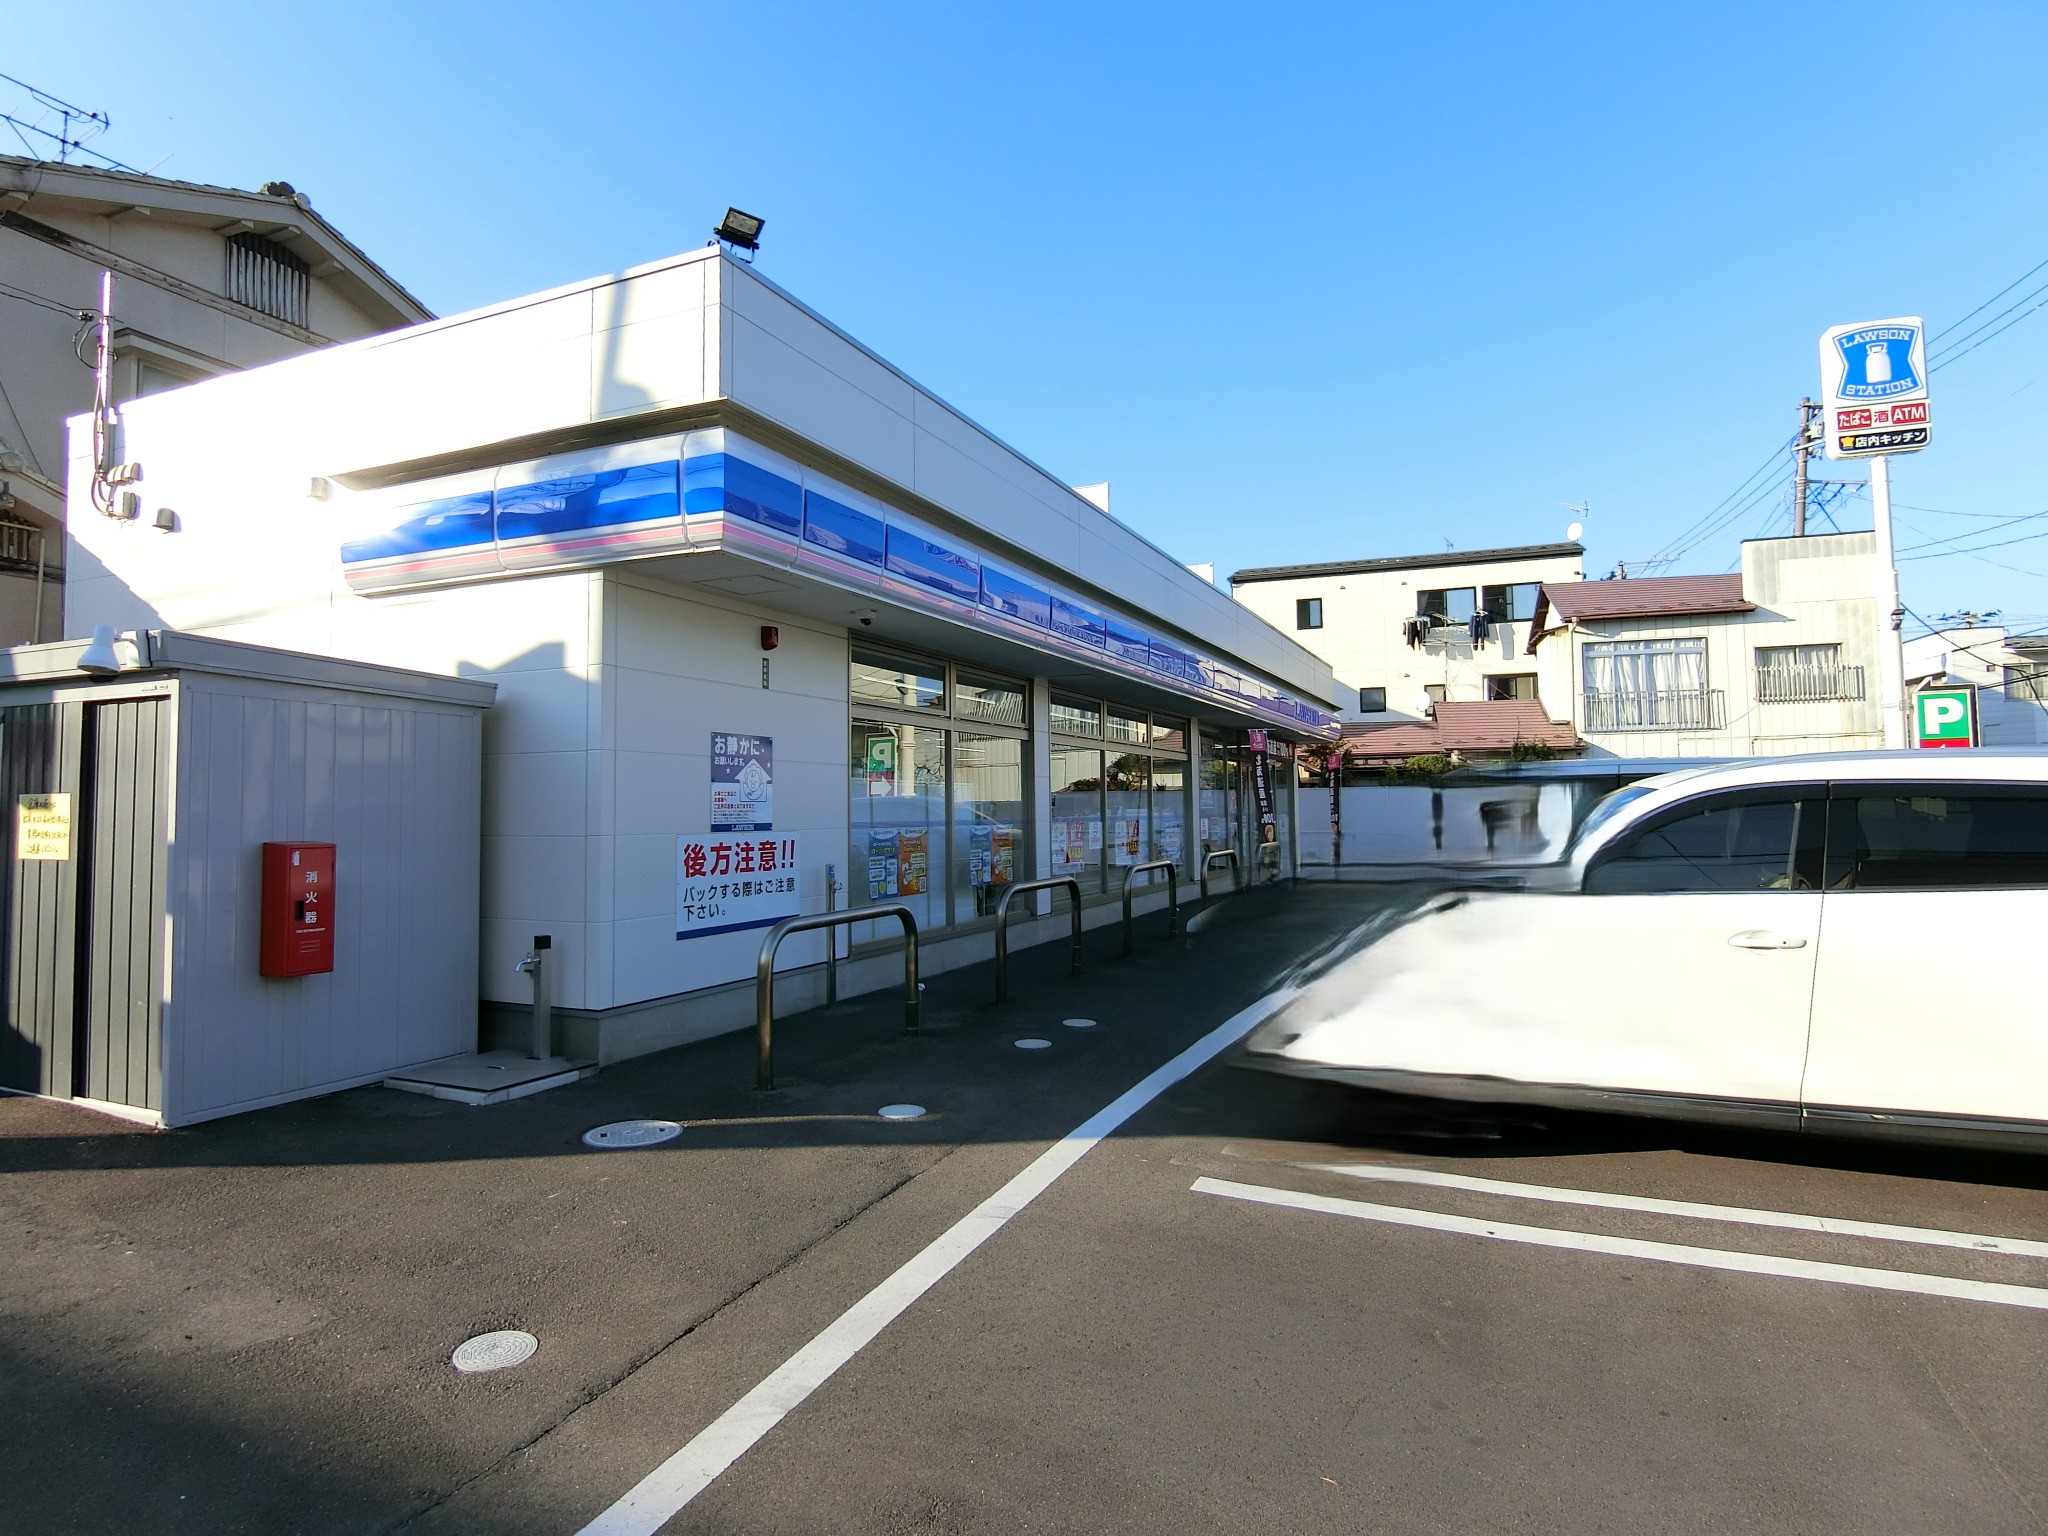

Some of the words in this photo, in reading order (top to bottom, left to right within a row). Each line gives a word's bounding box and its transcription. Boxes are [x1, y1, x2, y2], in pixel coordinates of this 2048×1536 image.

[1841, 329, 1911, 349] LAWSON
[1845, 378, 1915, 396] STATION
[1838, 411, 1871, 428] たばこ
[1873, 410, 1889, 423] 酒
[1892, 405, 1925, 423] ATM
[1855, 430, 1926, 447] 店内キッチン
[1923, 697, 1964, 735] P
[714, 756, 745, 767] お願いします。
[683, 839, 796, 878] 後方注意!!
[305, 871, 318, 924] 消火器
[683, 877, 796, 903] バックする際はご注意
[683, 903, 726, 922] 下さい。
